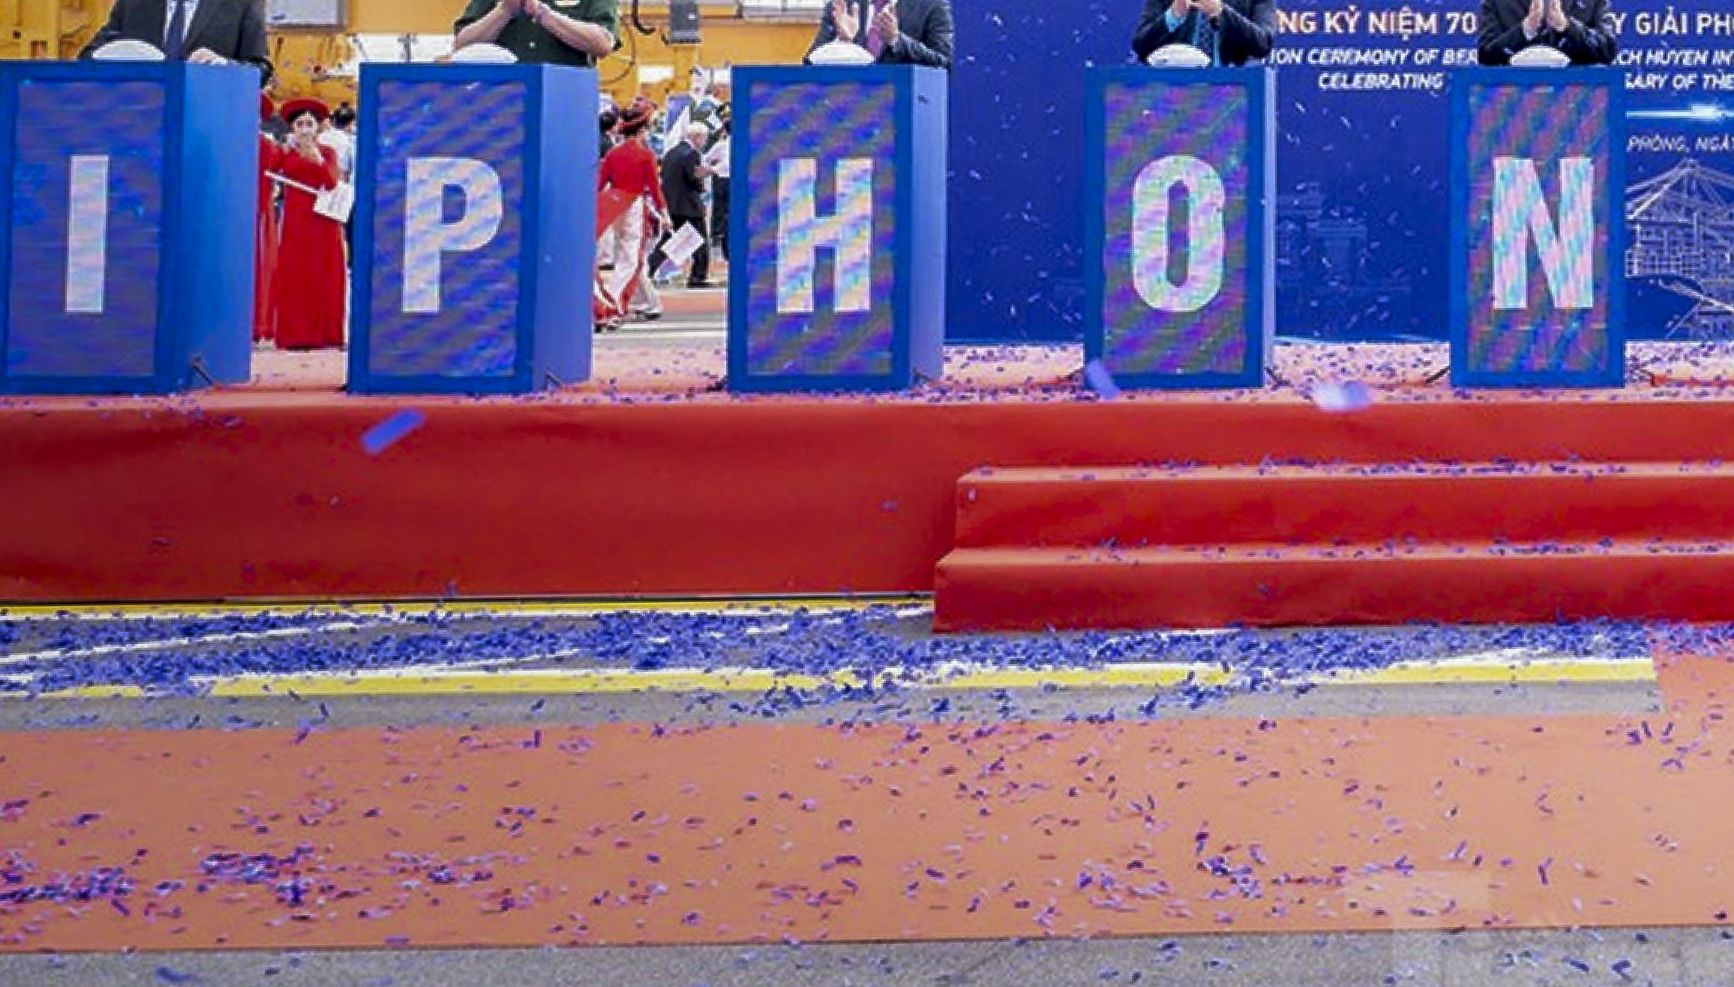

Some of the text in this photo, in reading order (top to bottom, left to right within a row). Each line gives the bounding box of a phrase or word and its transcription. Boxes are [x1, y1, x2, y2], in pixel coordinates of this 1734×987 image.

[1276, 10, 1318, 35] NG
[1368, 5, 1438, 41] NIỆM
[1445, 12, 1478, 34] 70
[1635, 5, 1688, 35] GIẢI
[1307, 48, 1409, 65] CEREMONY
[1415, 48, 1439, 65] OF
[1442, 48, 1479, 66] BER
[1646, 49, 1708, 66] HUYEN
[1318, 72, 1444, 90] CELEBRATING
[1672, 73, 1698, 89] OF
[65, 154, 109, 314] I
[403, 156, 503, 314] P
[776, 157, 874, 314] H
[1131, 154, 1226, 313] O
[1492, 157, 1595, 309] N
